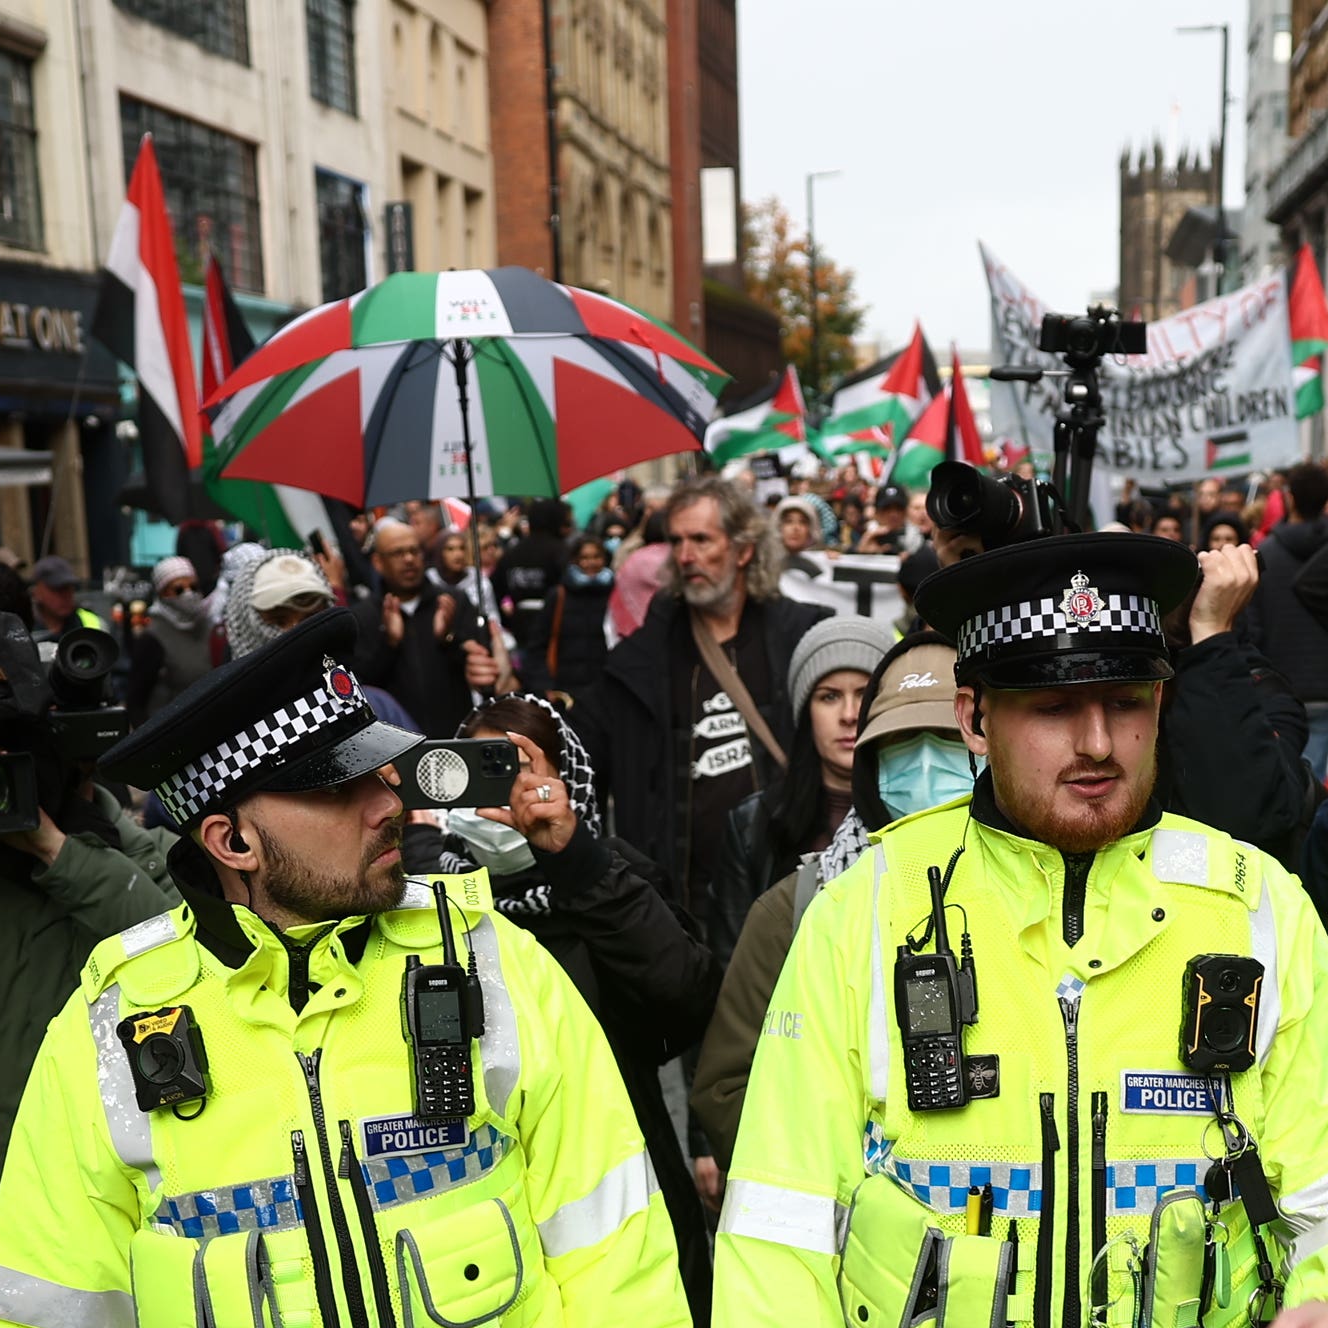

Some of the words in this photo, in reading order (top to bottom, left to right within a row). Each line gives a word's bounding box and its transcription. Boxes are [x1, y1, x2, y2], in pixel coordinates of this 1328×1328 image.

[898, 671, 939, 692] Polar
[1234, 851, 1247, 893] 09654
[462, 877, 480, 906] 03702
[151, 1017, 168, 1027] VIDEO
[157, 1021, 174, 1031] AUDIO
[1127, 1076, 1164, 1088] GREATER
[166, 1090, 185, 1103] AXON
[1140, 1089, 1207, 1109] POLICE
[366, 1120, 404, 1135] GREATER
[380, 1126, 450, 1151] POLICE
